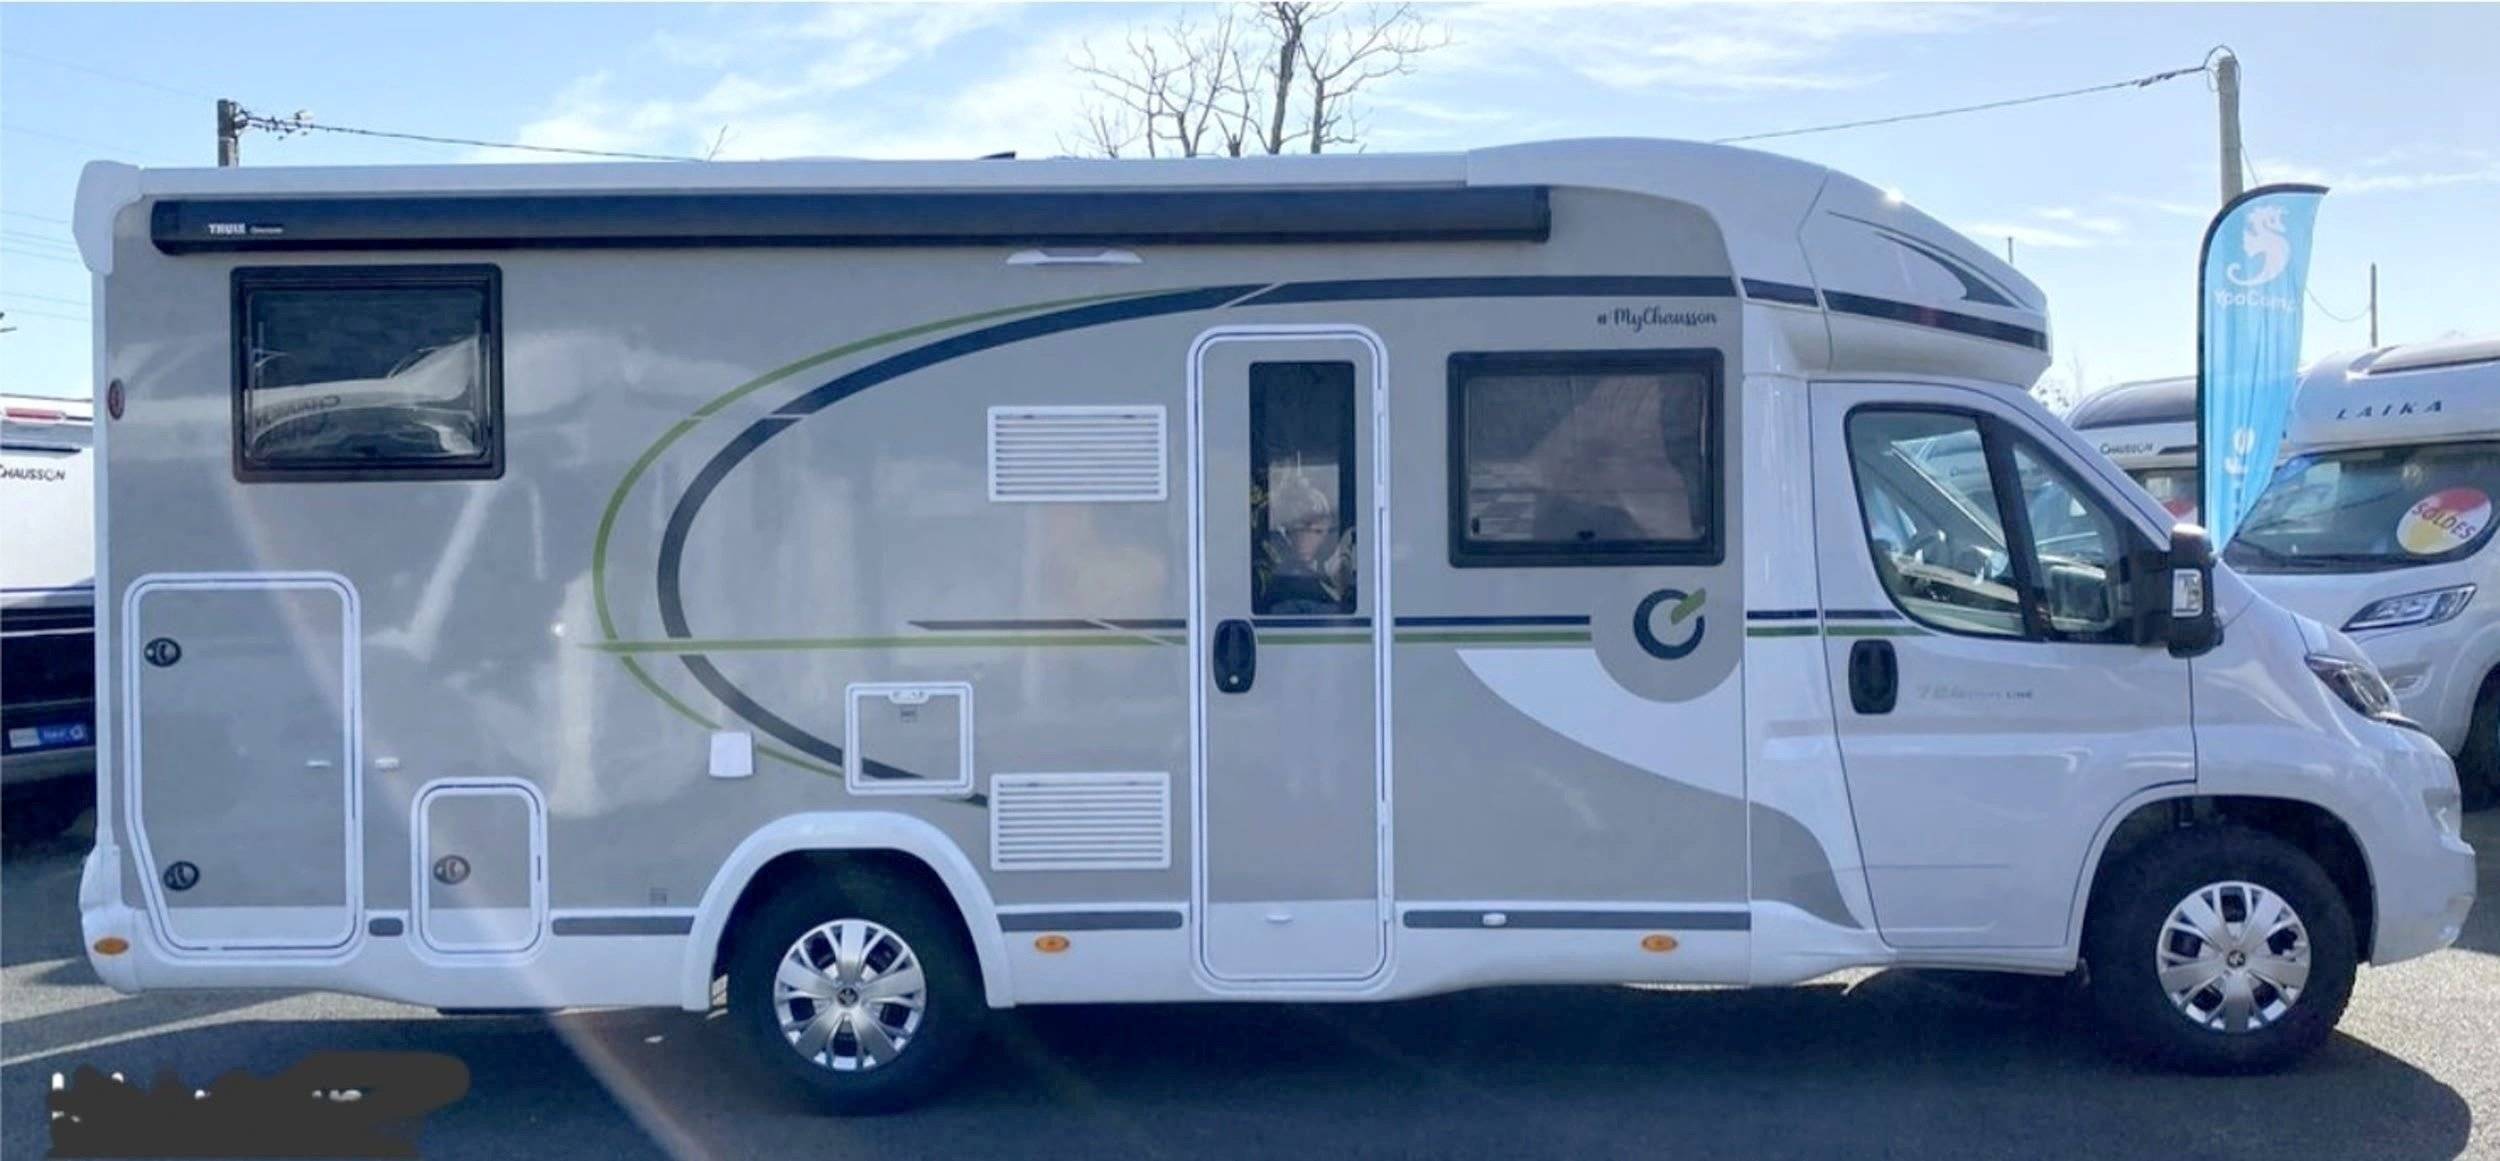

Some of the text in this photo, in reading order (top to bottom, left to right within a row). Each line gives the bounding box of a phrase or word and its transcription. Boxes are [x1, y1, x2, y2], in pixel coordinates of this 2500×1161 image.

[208, 222, 246, 236] THULE
[2336, 399, 2443, 421] LAIKA
[2411, 502, 2477, 540] SOLDES
